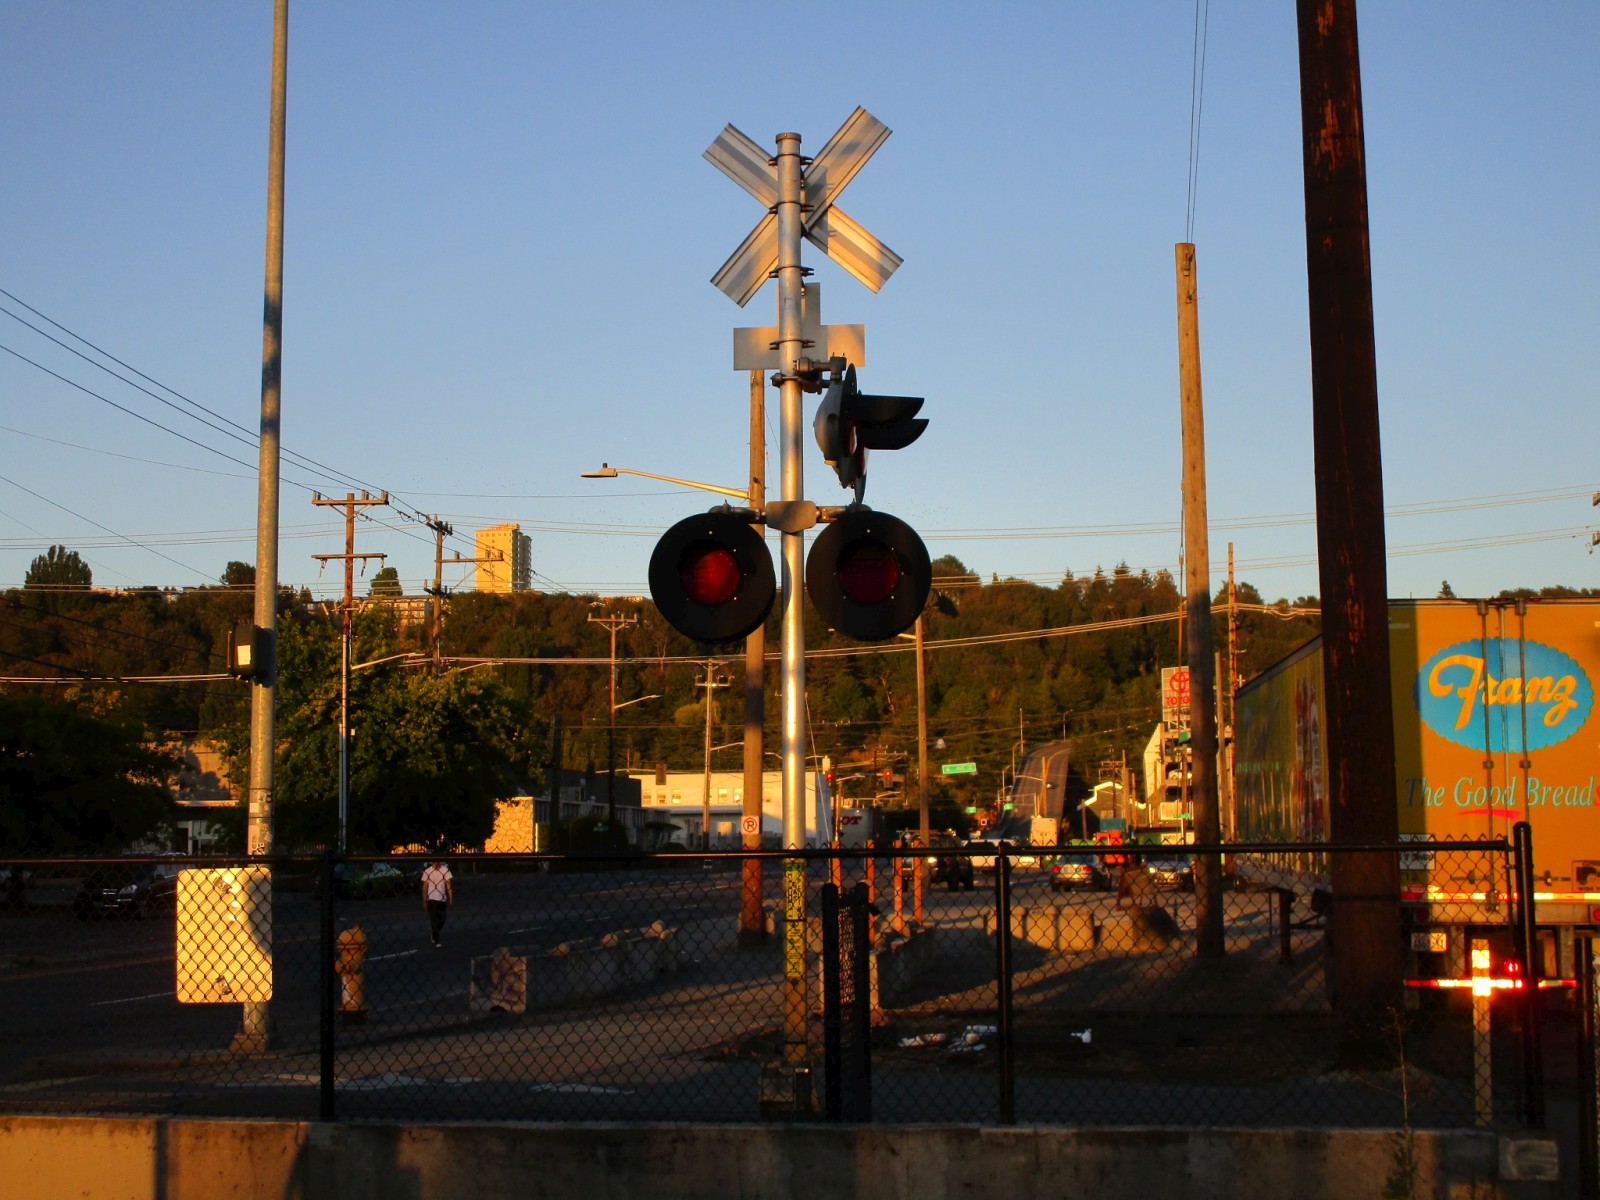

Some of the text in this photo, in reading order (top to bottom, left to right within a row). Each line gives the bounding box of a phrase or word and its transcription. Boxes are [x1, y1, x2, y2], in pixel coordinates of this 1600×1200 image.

[1165, 696, 1191, 705] TOYO
[1428, 654, 1578, 731] Franz
[1405, 777, 1446, 807] The
[1454, 777, 1517, 807] Good
